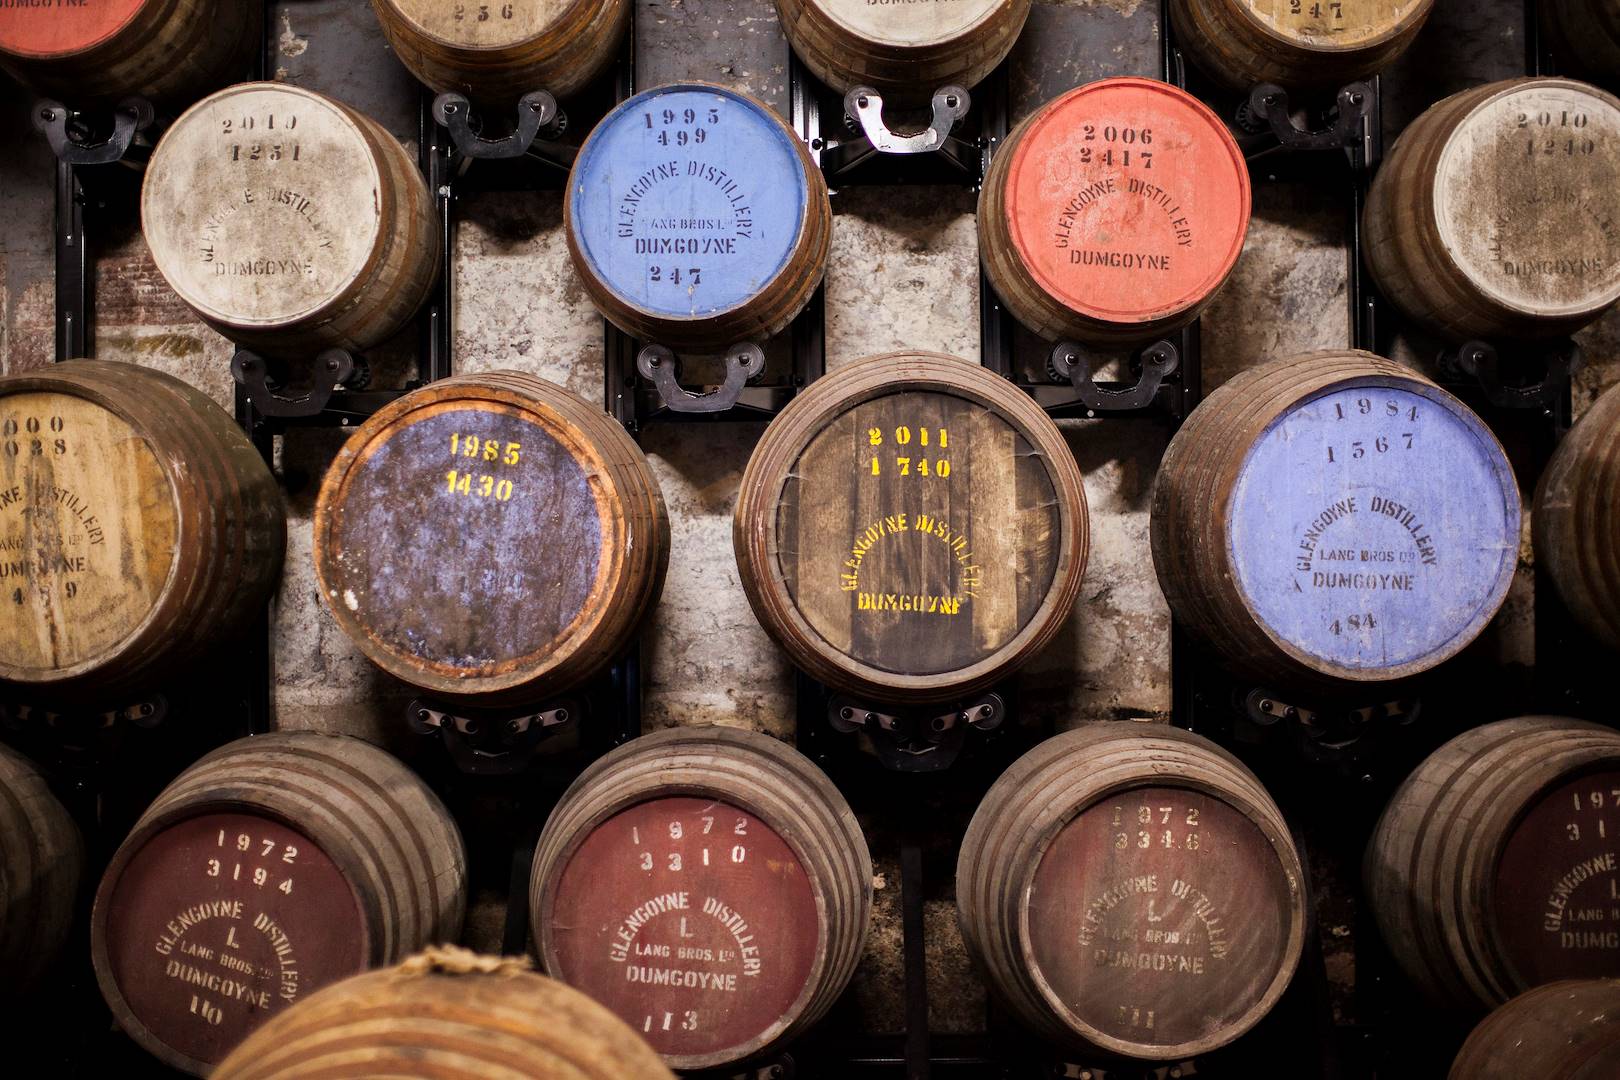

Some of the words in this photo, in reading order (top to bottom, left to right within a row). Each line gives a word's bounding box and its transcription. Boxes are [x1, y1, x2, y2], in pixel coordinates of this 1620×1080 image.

[1291, 0, 1341, 19] 247
[222, 114, 297, 134] 2010
[645, 109, 719, 129] 1995
[1518, 110, 1587, 128] 2010
[657, 128, 706, 146] 499
[1083, 125, 1152, 144] 2006
[232, 145, 300, 161] 1251
[1080, 147, 1152, 168] 2417
[1527, 139, 1594, 156] 1240
[618, 161, 680, 238] GLENGOYNE
[687, 161, 752, 238] DISTILLERY
[1055, 178, 1116, 249] GLENGOYNE
[1128, 178, 1192, 248] DISTILLERY
[635, 238, 736, 254] DUMGOYNE
[1070, 250, 1170, 270] DUMGOYNE
[650, 266, 702, 285] 247
[1335, 398, 1419, 422] 1984
[868, 426, 948, 448] 2011
[1327, 432, 1413, 463] 1567
[451, 432, 521, 465] 1985
[871, 457, 950, 478] 1740
[447, 470, 513, 502] 1430
[1296, 497, 1358, 572] GLENGOYNE
[1371, 496, 1437, 566] DISTILLERY
[840, 513, 908, 592] GLENGOYNE
[915, 514, 982, 599] DISTILLERY
[1320, 550, 1355, 562] LANG
[1313, 572, 1415, 591] DUMGOYNE
[858, 592, 963, 615] DUMGOYNE
[1329, 613, 1377, 636] 484
[1112, 806, 1200, 826] 1972
[633, 816, 747, 844] 1972
[217, 829, 298, 864] 1972
[639, 846, 745, 871] 3310
[207, 859, 293, 895] 3194
[1544, 852, 1618, 932] GLENGOYNE
[1148, 900, 1162, 922] L
[1568, 908, 1604, 921] LANG
[226, 926, 239, 949] L
[610, 891, 690, 962] GLENGOYNE
[703, 896, 760, 976] DISTILLERY
[680, 916, 694, 938] L
[155, 900, 244, 955] GLENGOYNE
[253, 912, 298, 1004] DISTILLERY
[181, 940, 213, 961] LANG
[219, 953, 255, 976] BROS.
[635, 943, 670, 957] LANG
[678, 947, 715, 961] BROS.
[166, 960, 271, 1010] DUMGOYNE
[626, 966, 736, 991] DUMGOYNE
[190, 996, 223, 1025] 110
[644, 1011, 698, 1032] 113
